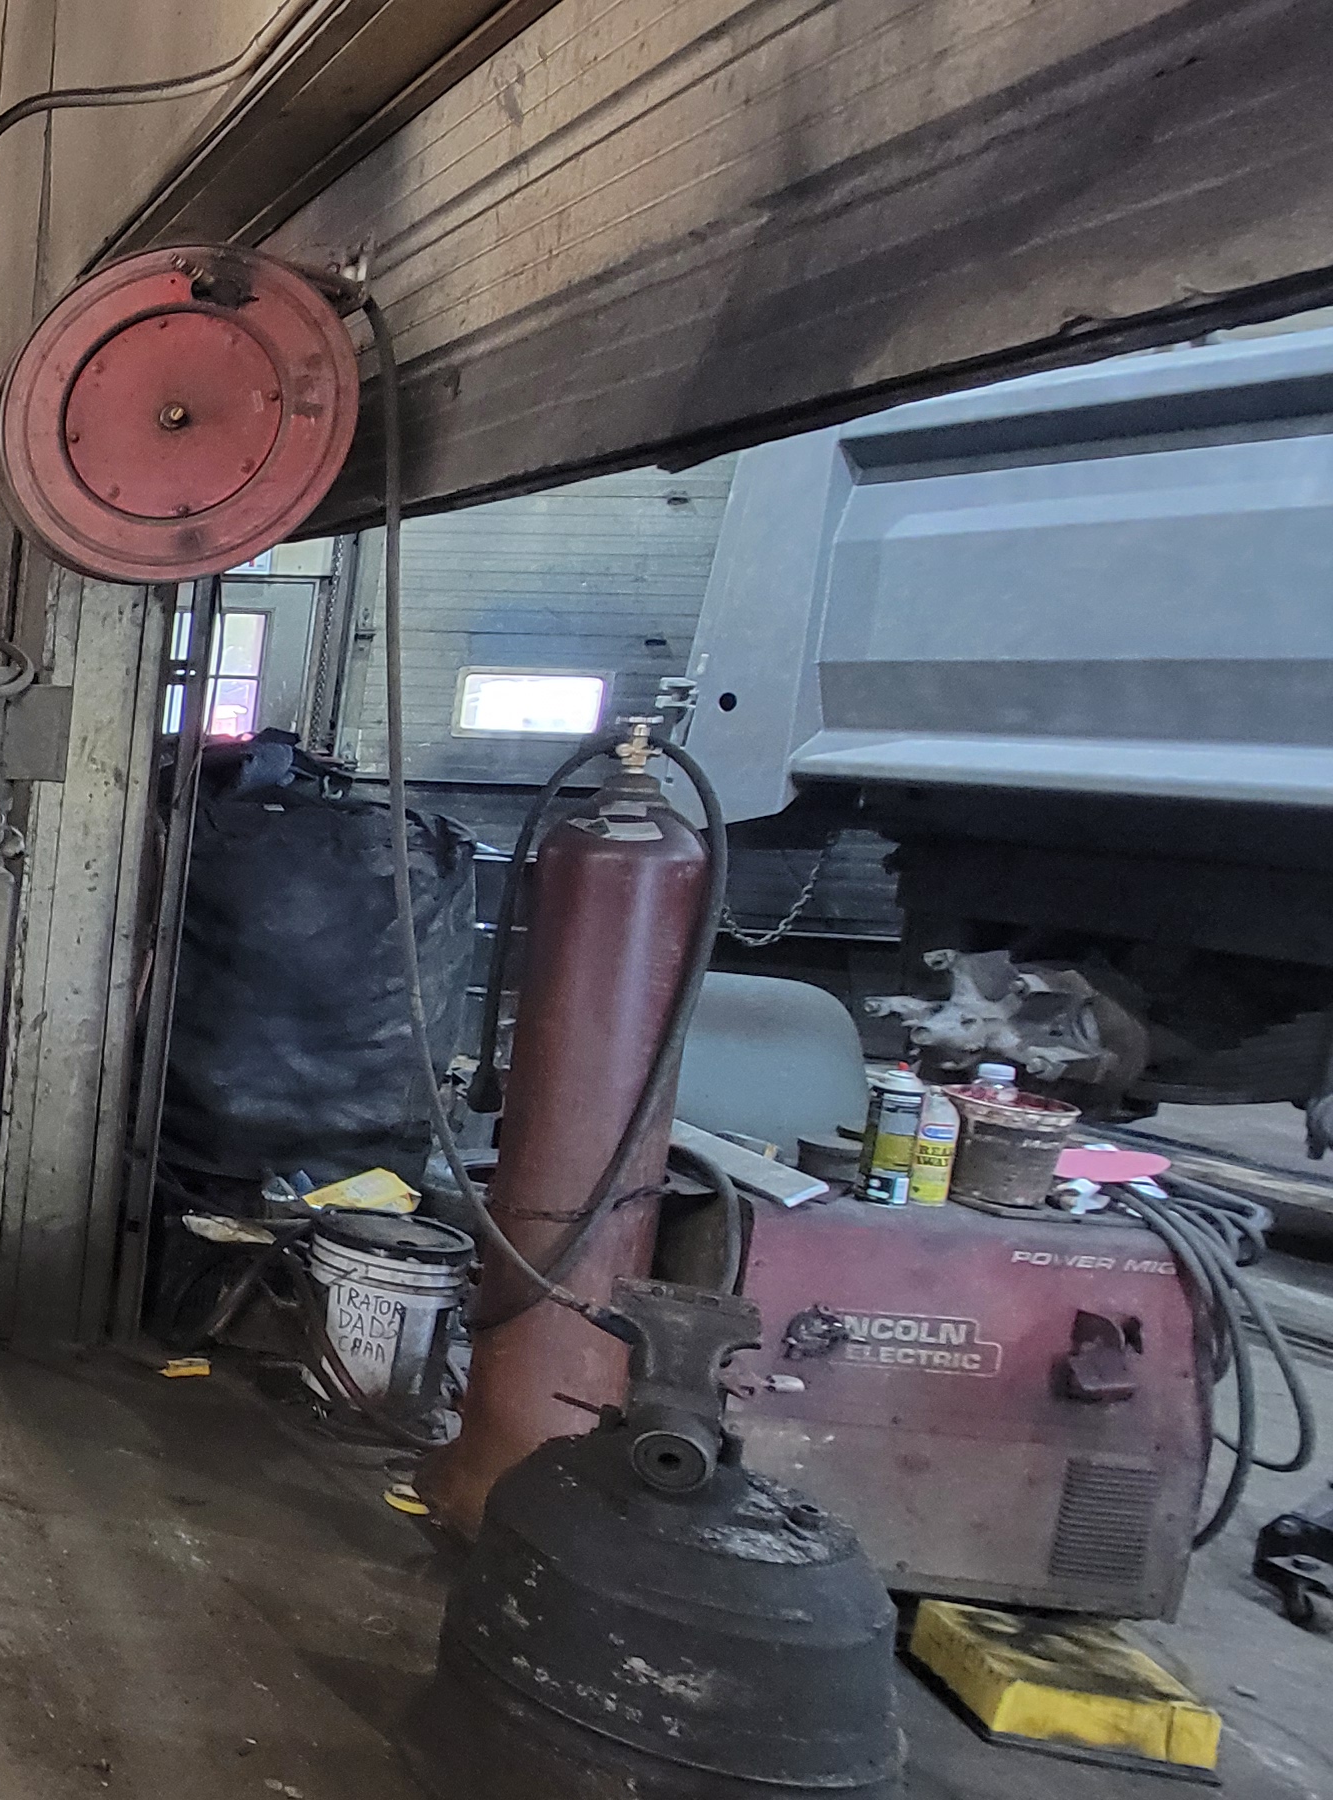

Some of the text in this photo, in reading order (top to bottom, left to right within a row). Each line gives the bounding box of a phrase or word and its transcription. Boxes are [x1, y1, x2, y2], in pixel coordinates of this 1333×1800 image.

[1123, 1259, 1177, 1275] MIG
[843, 1315, 968, 1346] NCOLN
[844, 1343, 982, 1370] ELECTRIC
